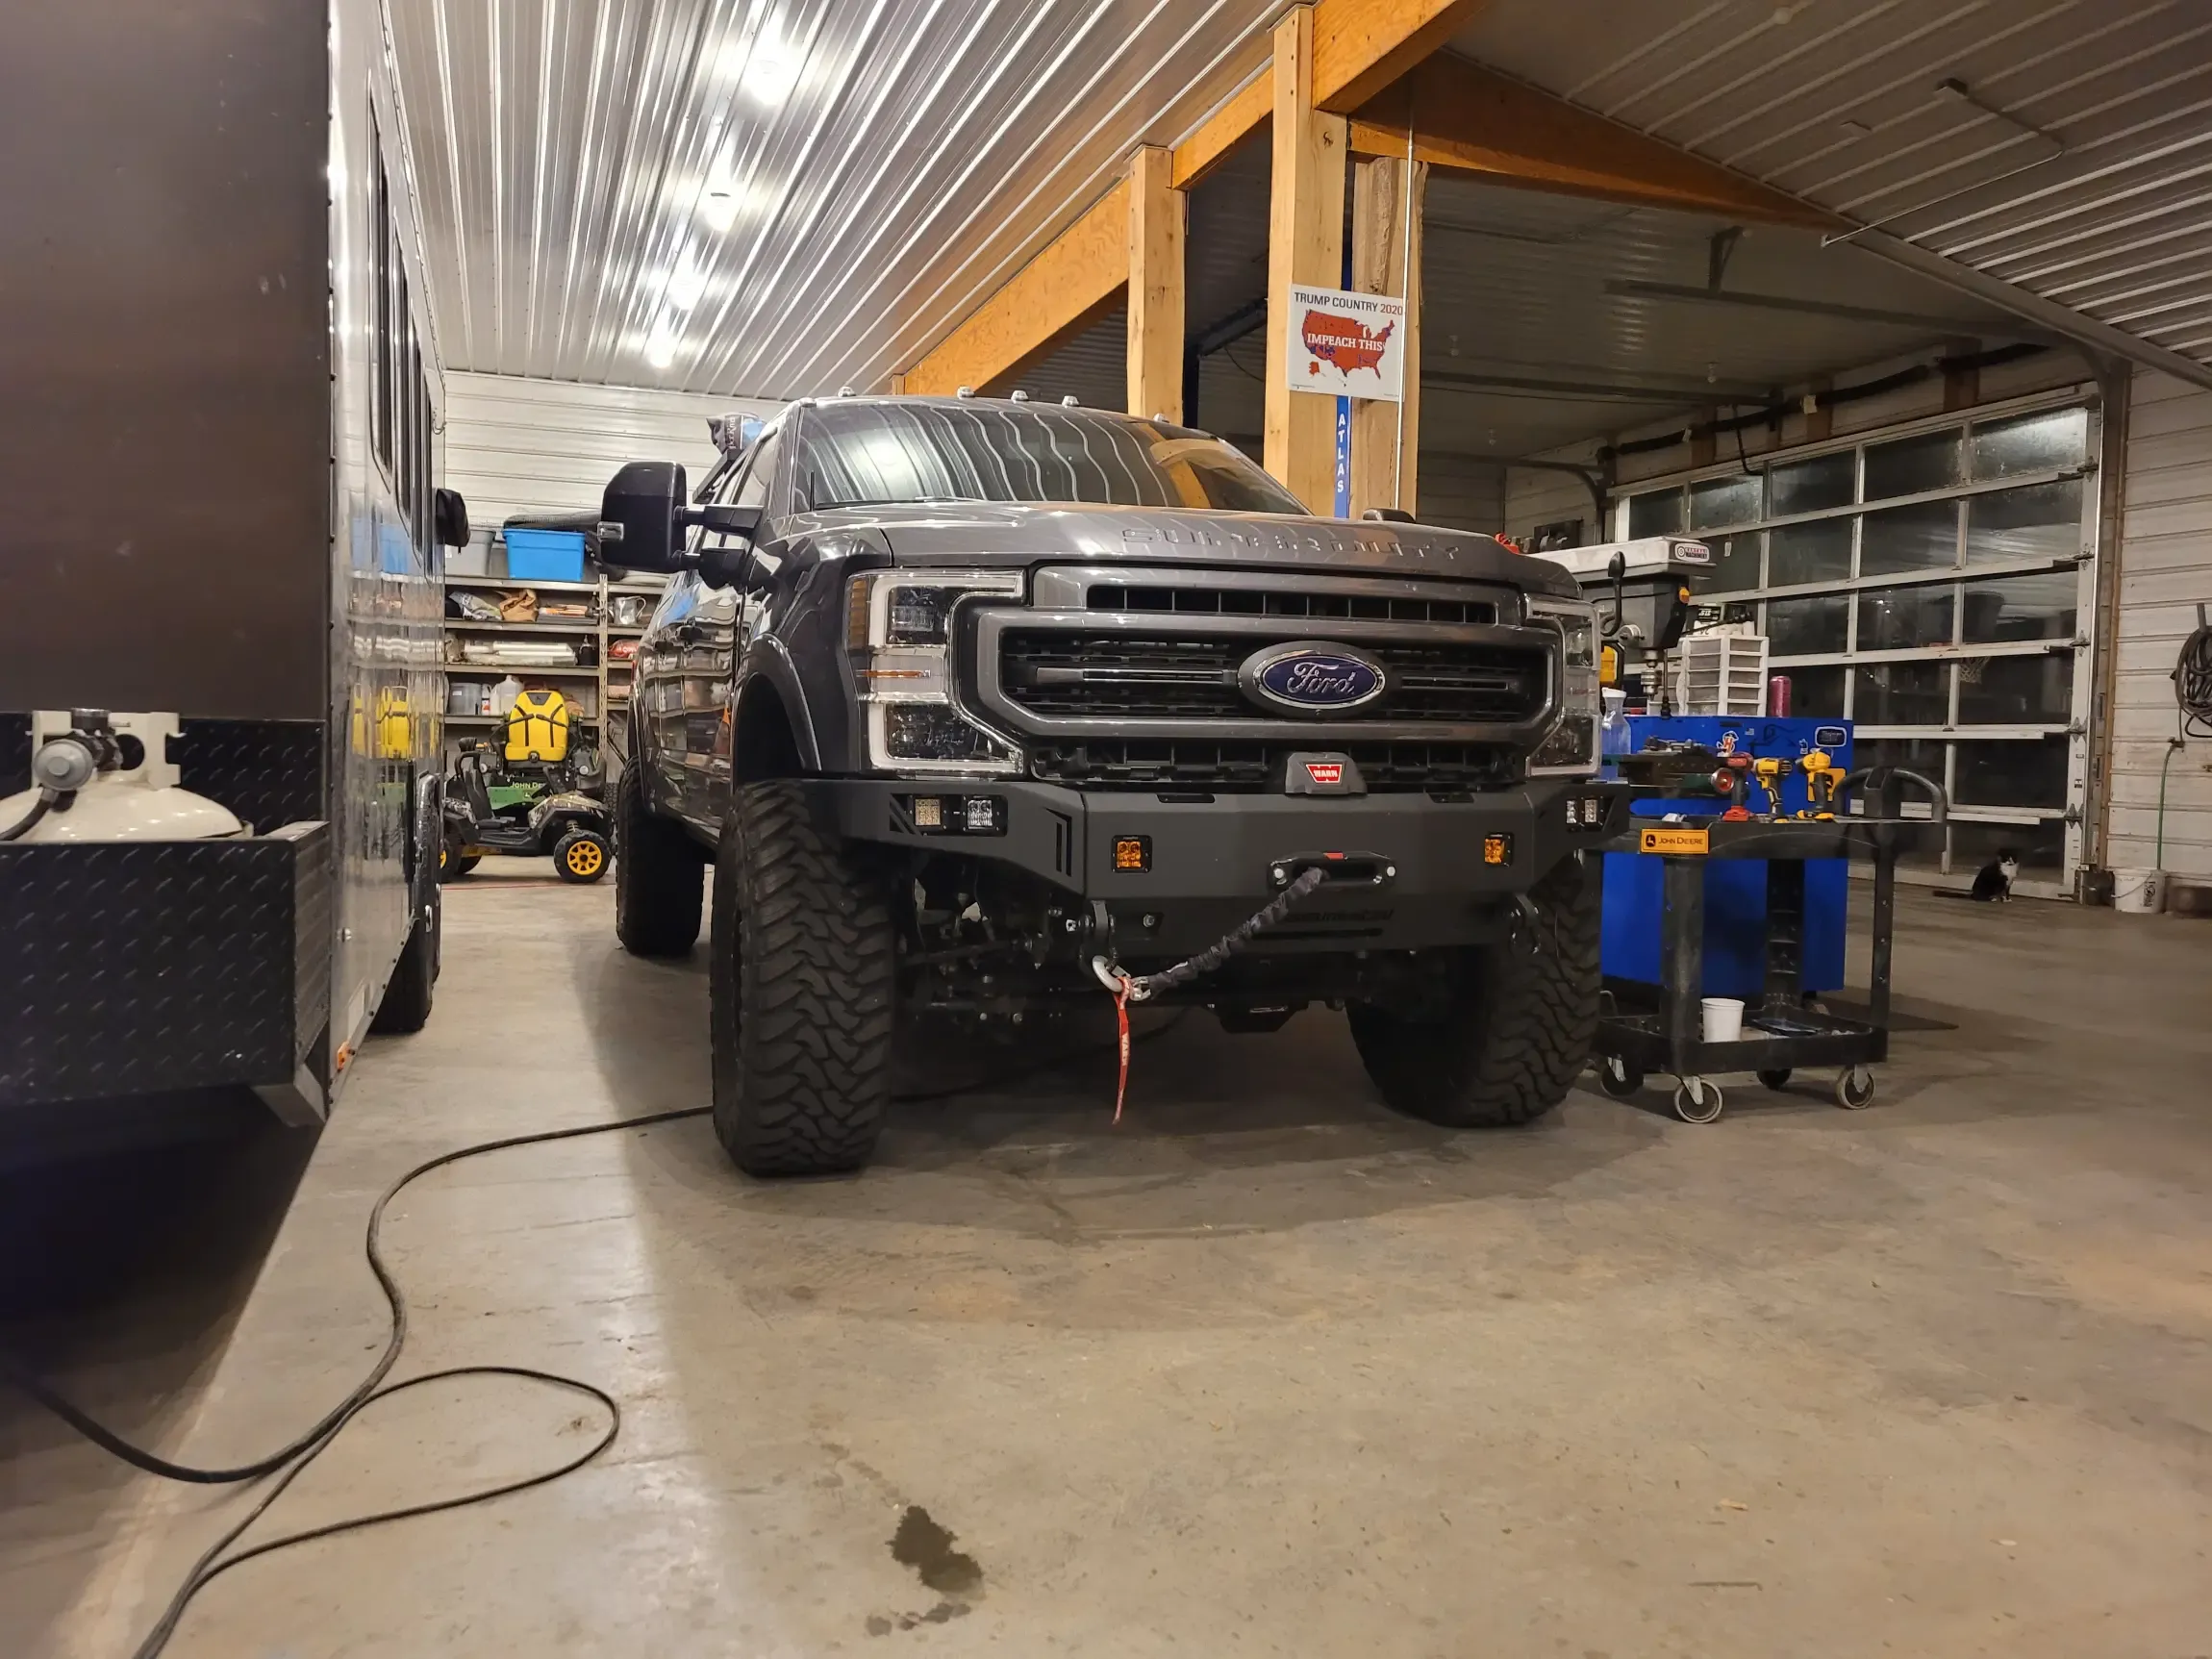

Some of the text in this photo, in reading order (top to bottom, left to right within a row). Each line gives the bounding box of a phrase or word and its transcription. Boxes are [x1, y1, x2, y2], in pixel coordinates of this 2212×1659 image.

[1295, 291, 1403, 315] TRUMP COUNTRY 2020
[1307, 333, 1383, 352] IMPEACH THIS
[1337, 413, 1346, 493] ATLAS
[1287, 662, 1357, 694] Ford
[1313, 769, 1339, 778] WARN
[1658, 836, 1704, 845] JOHN DEERE
